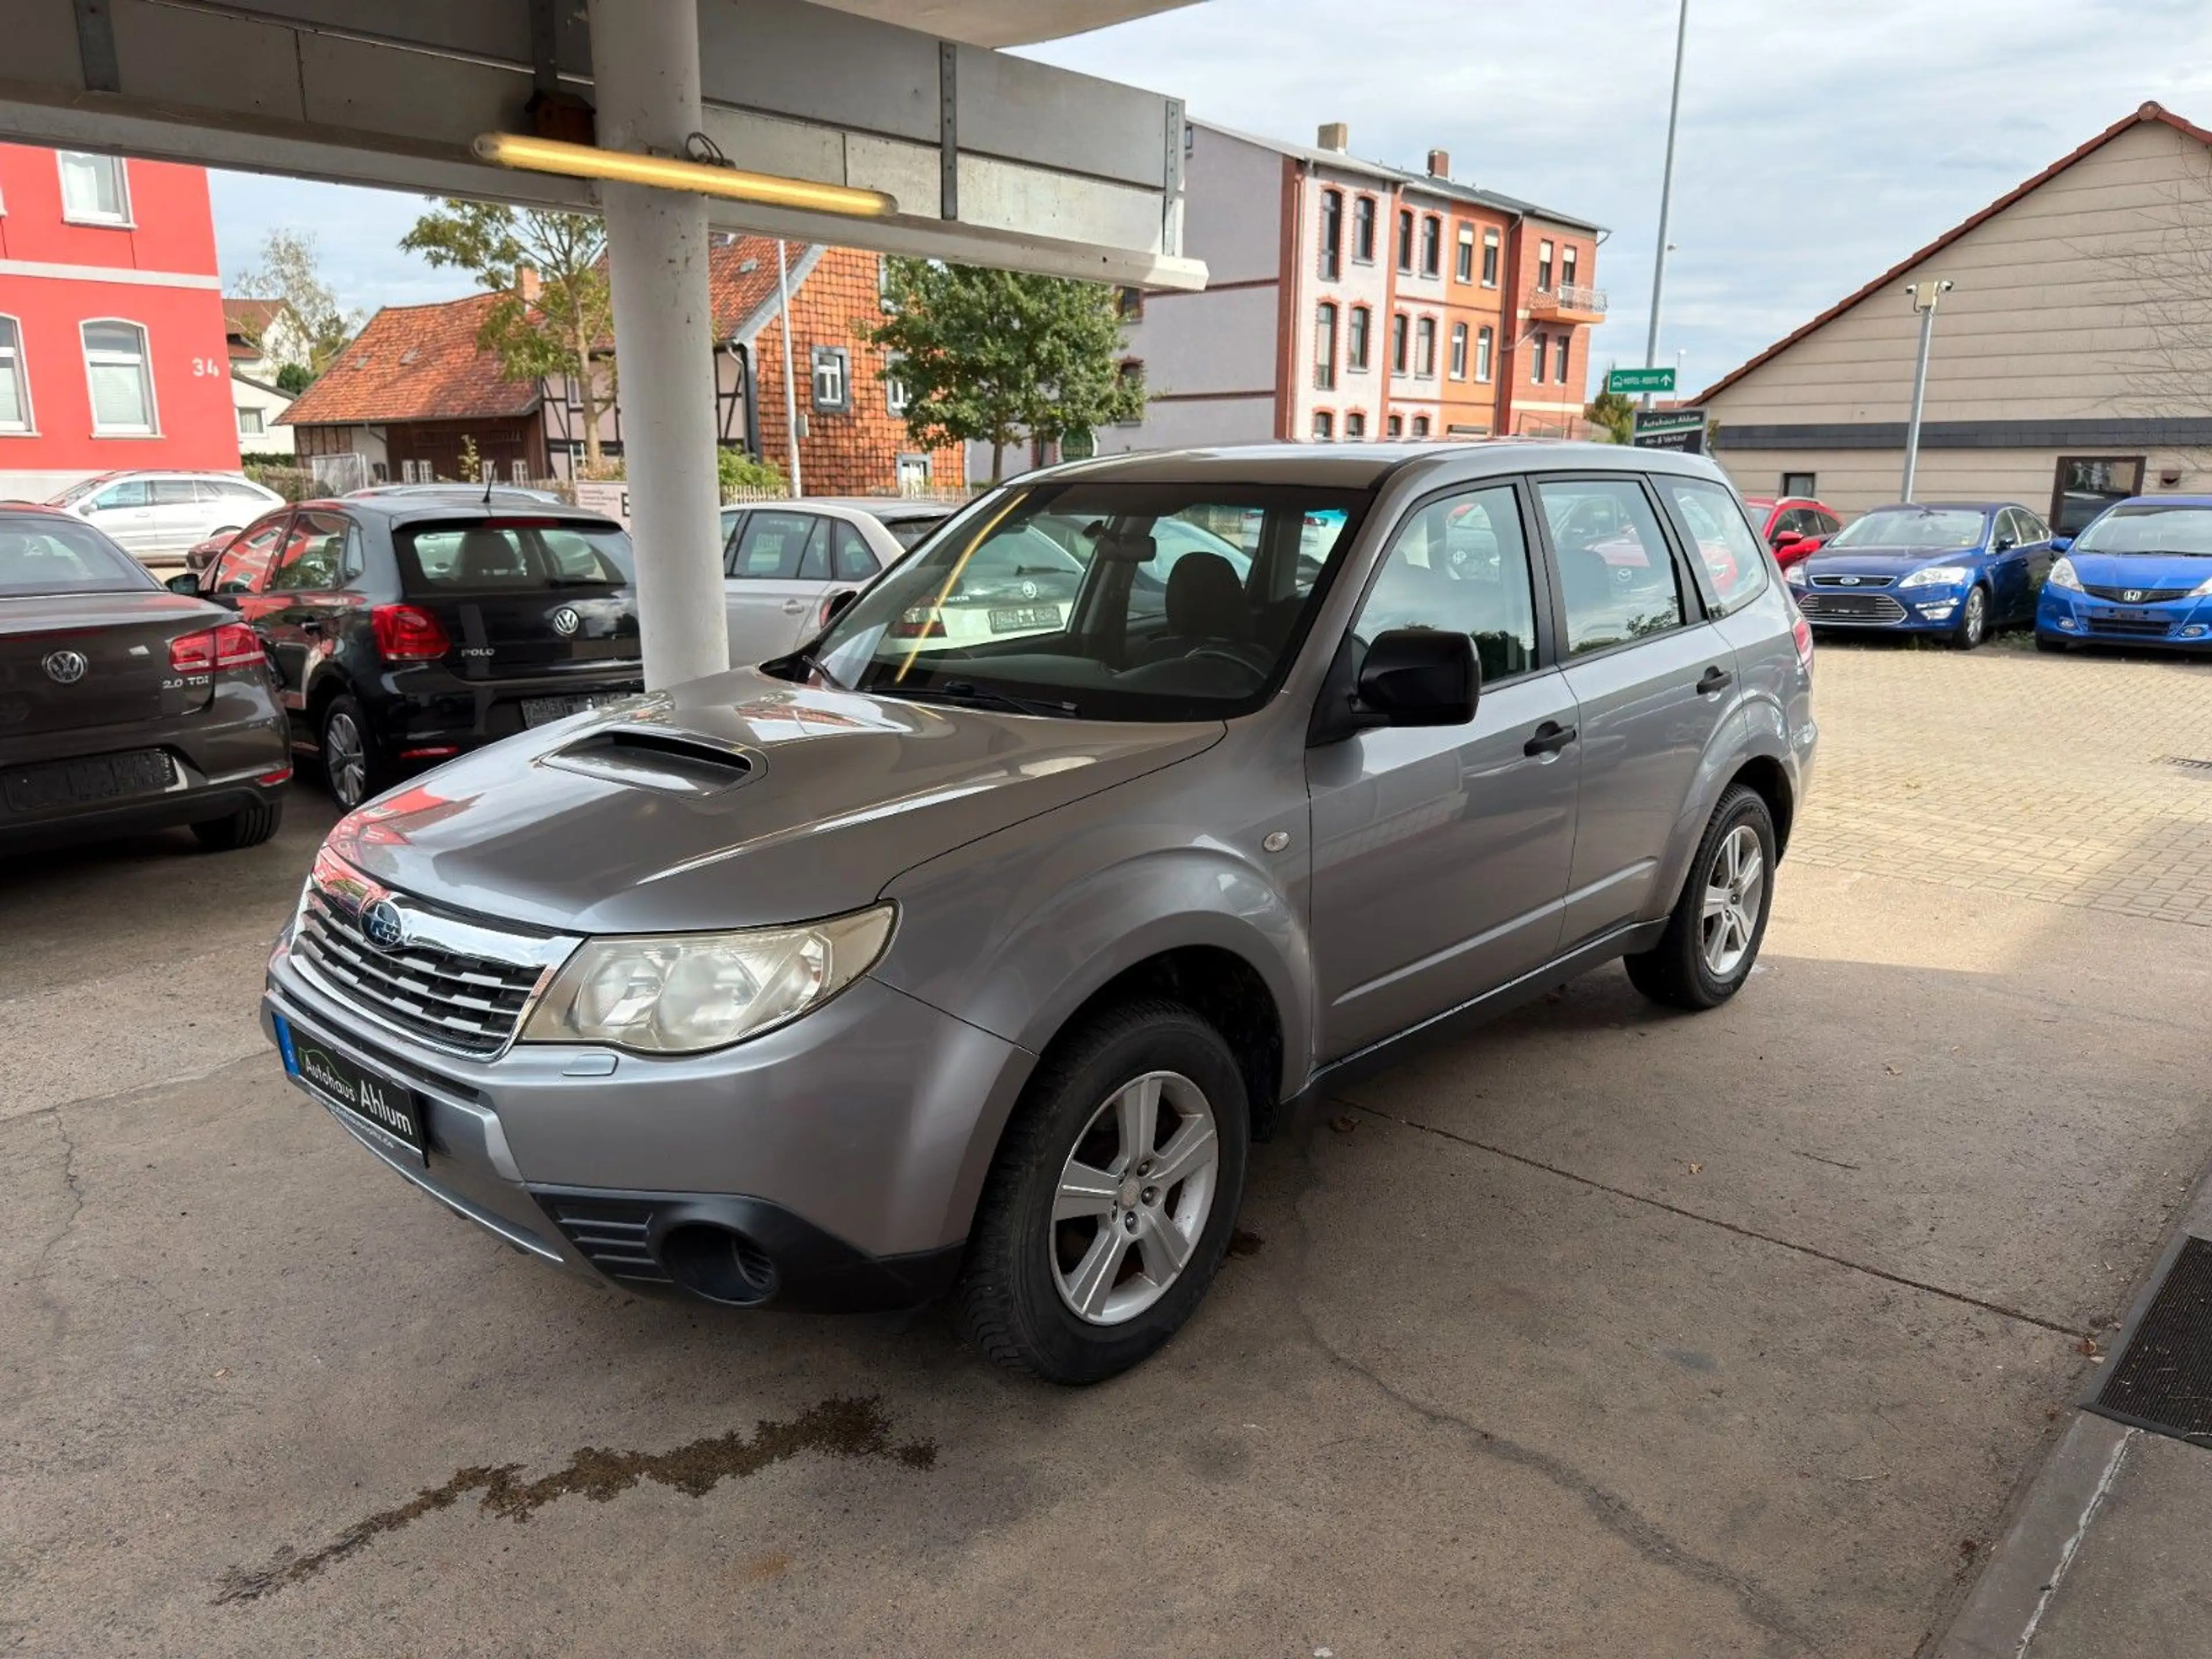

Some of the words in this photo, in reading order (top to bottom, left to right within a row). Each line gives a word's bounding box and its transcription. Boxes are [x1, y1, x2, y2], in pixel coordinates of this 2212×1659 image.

[192, 357, 219, 377] 34
[1643, 419, 1676, 428] Autohaus
[1677, 414, 1700, 423] Ahlum
[461, 648, 495, 657] POLO
[187, 676, 209, 686] TDI
[305, 1054, 355, 1102] Autohaus
[361, 1080, 412, 1136] Ahlum
